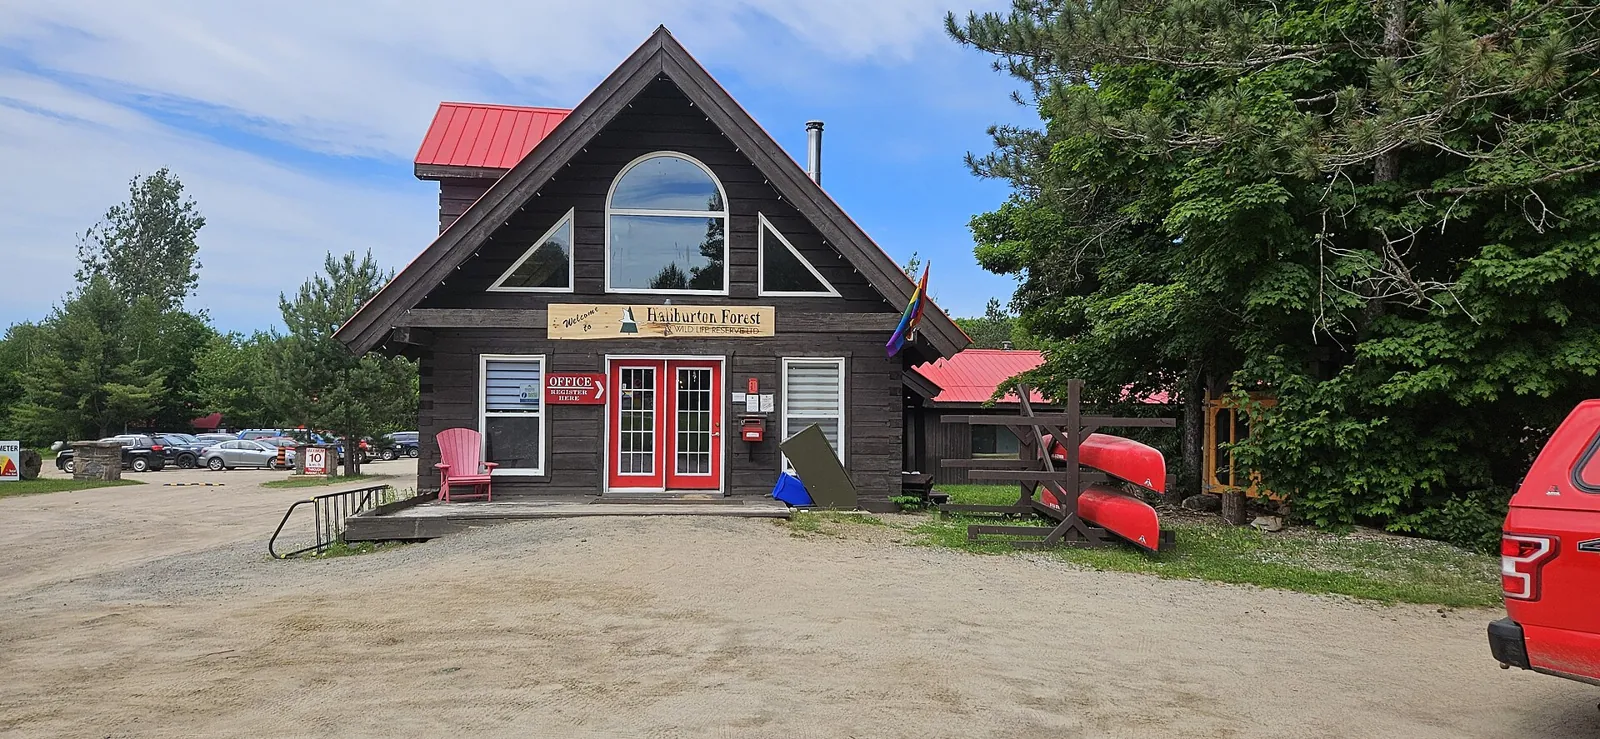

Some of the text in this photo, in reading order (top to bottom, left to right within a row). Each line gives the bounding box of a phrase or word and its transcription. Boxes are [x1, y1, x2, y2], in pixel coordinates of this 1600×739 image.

[562, 306, 599, 328] Welcome
[647, 307, 760, 325] Haliburton Forest
[583, 324, 592, 332] to
[675, 325, 694, 333] WILD
[696, 326, 710, 334] LIFE
[549, 377, 592, 386] OFFICE
[309, 453, 322, 462] 10
